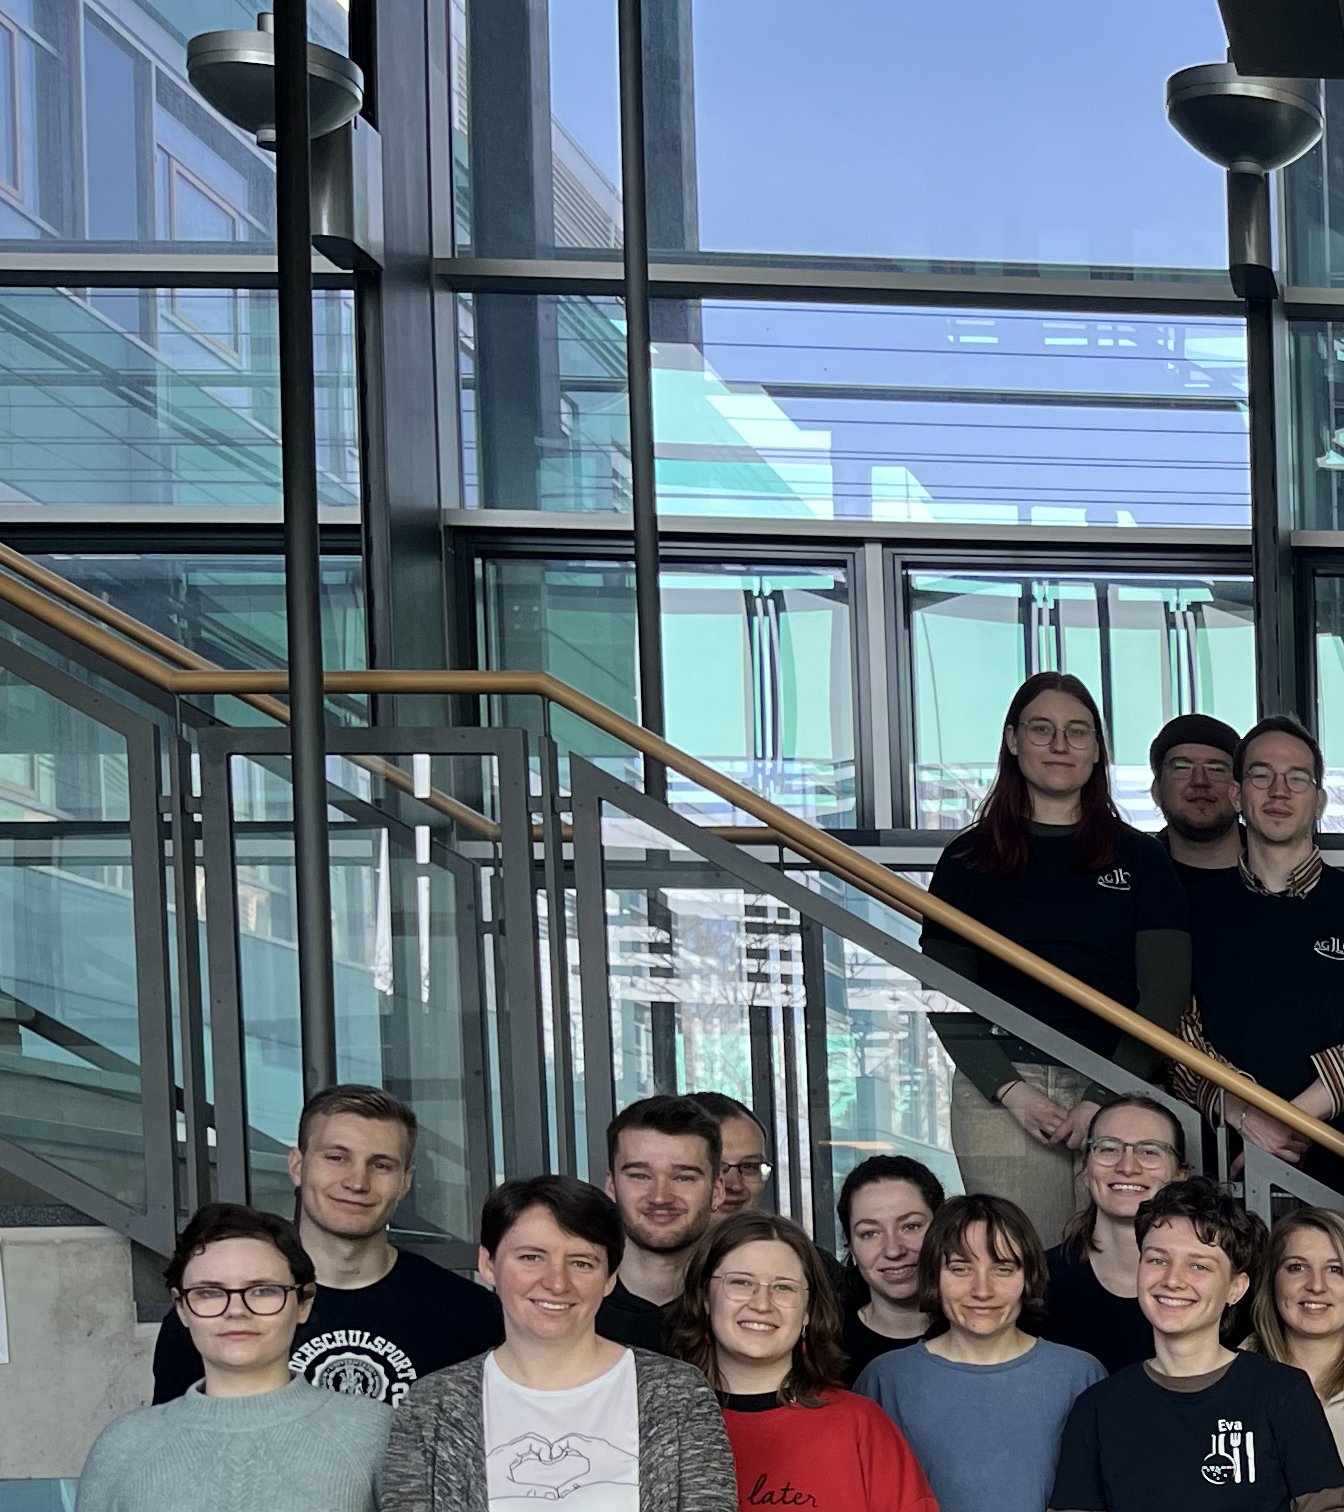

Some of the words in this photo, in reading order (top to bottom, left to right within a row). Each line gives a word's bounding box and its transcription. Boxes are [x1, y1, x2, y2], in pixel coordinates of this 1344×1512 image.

[287, 1329, 418, 1381] OCHSCHULSPORT
[1217, 1418, 1243, 1433] Eva
[747, 1472, 818, 1508] later
